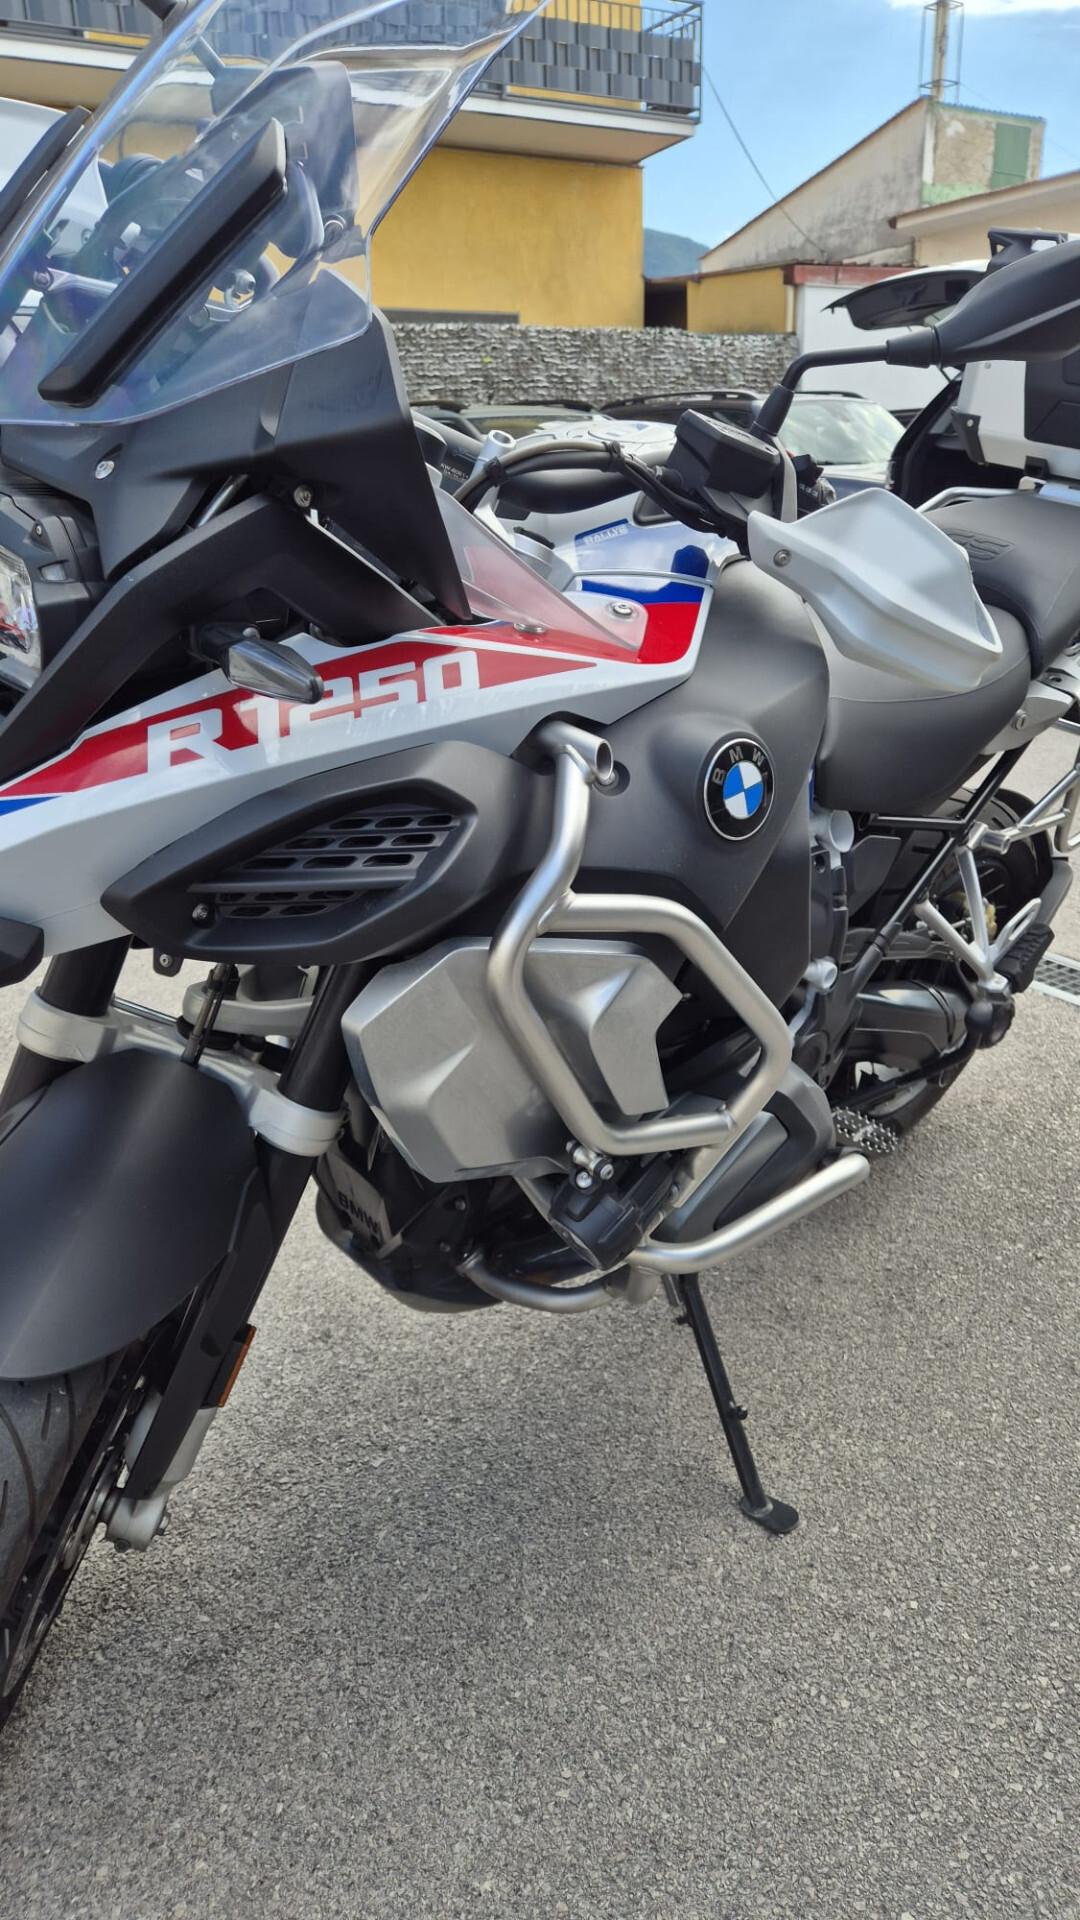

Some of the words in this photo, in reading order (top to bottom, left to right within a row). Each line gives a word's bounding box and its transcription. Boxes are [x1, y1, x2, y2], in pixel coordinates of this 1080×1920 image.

[147, 707, 235, 774] R
[234, 650, 480, 755] 1250
[712, 745, 765, 786] BMW
[338, 1191, 379, 1234] BMW
